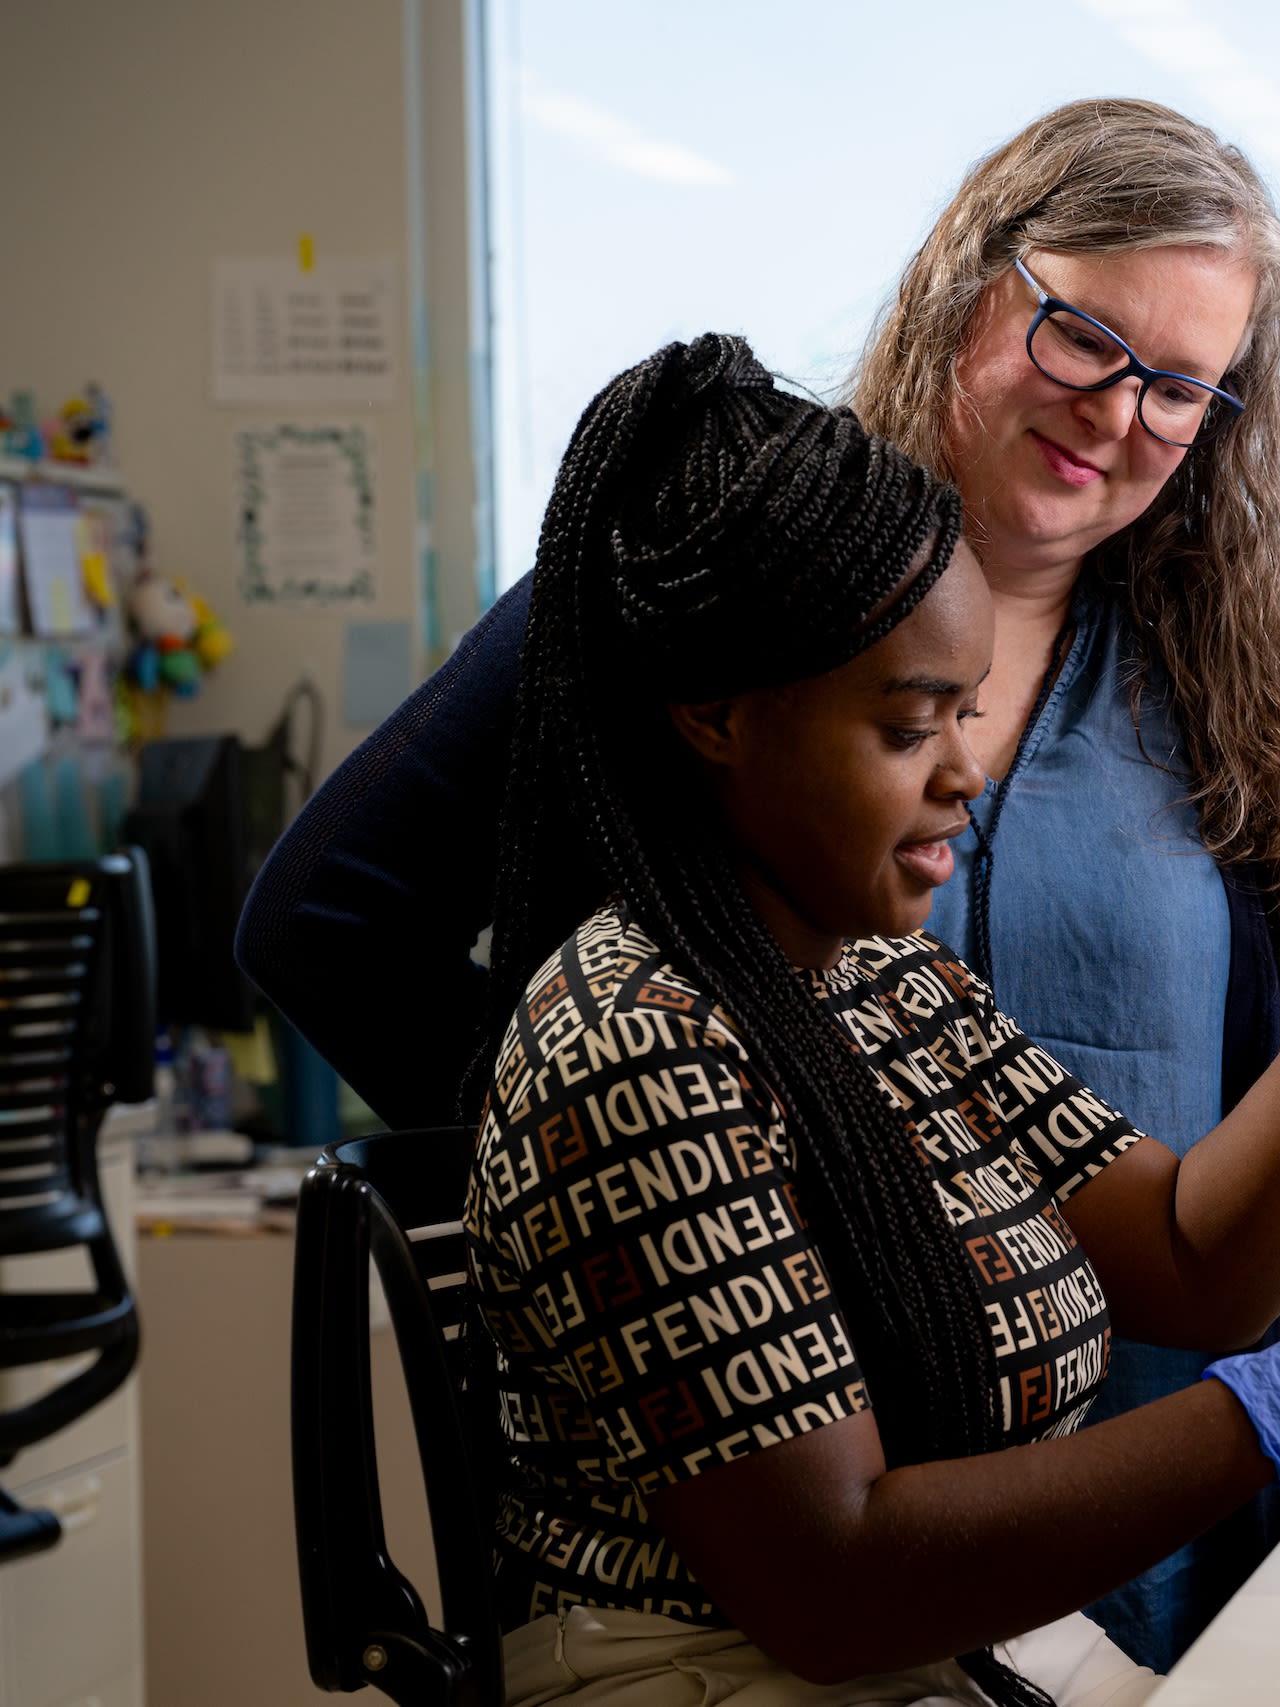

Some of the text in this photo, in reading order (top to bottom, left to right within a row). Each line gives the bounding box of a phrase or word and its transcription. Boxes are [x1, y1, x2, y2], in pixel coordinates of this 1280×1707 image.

[567, 1132, 733, 1238] FENDI
[996, 1213, 1069, 1275] FENDI
[619, 1265, 793, 1375] FENDI
